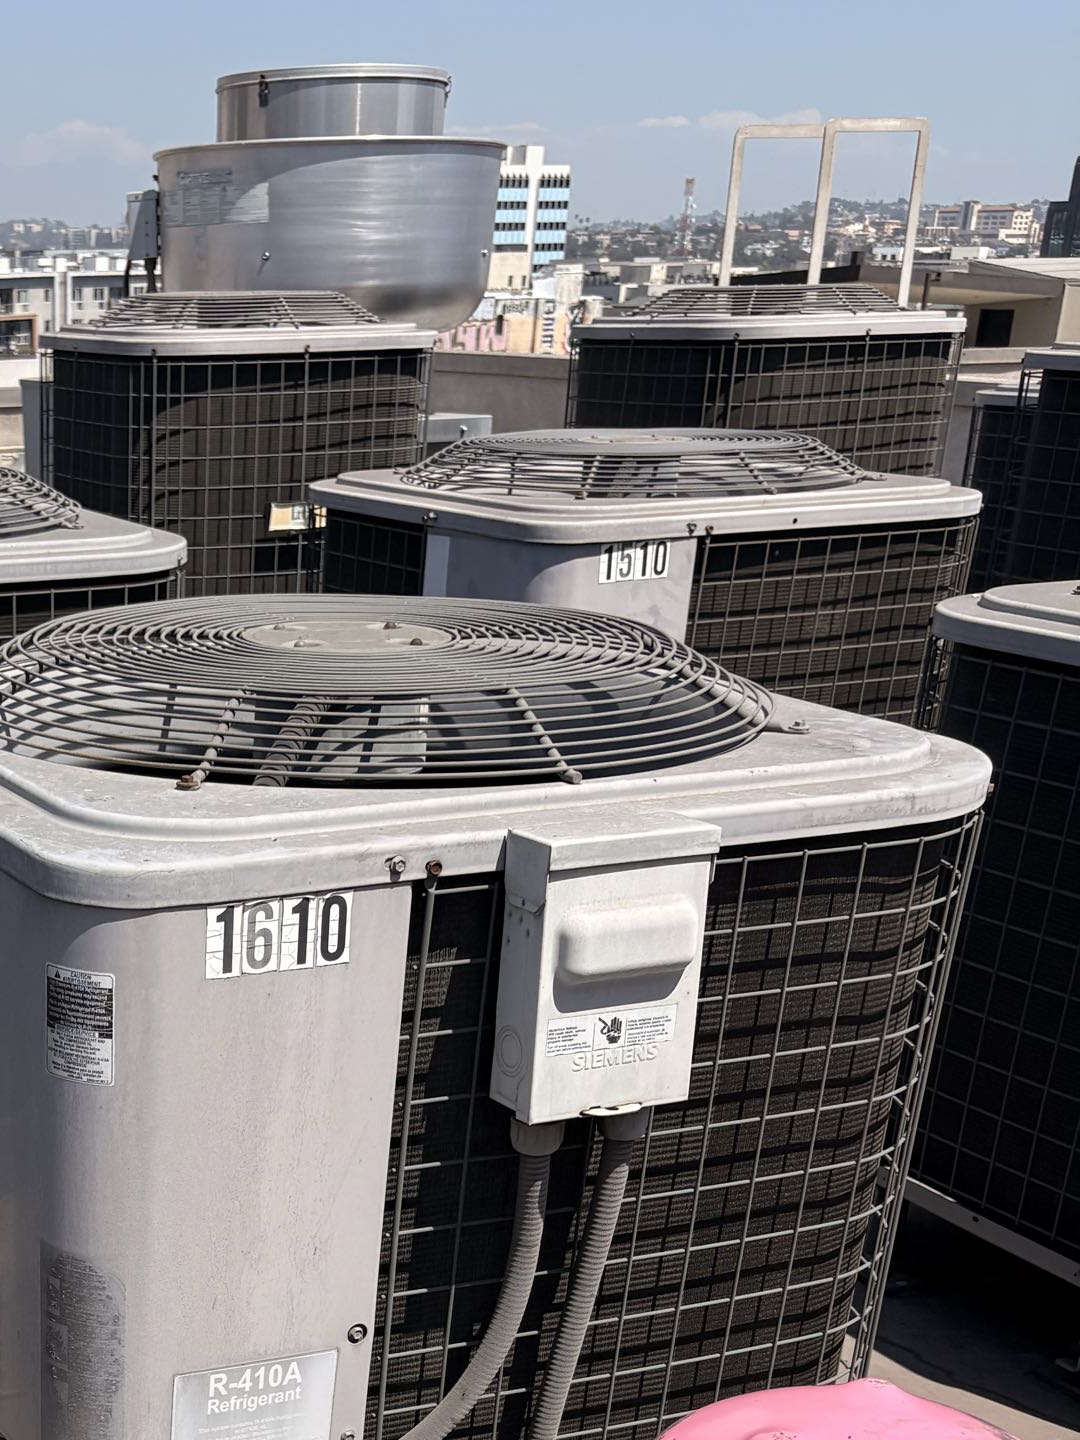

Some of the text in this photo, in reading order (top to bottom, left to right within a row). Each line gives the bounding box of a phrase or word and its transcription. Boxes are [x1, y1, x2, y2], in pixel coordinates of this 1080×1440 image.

[604, 541, 668, 581] 1510
[216, 895, 348, 974] 1610
[572, 1044, 658, 1073] SIEMENS
[208, 1361, 303, 1398] R-410A
[207, 1386, 302, 1415] Refrigerant
